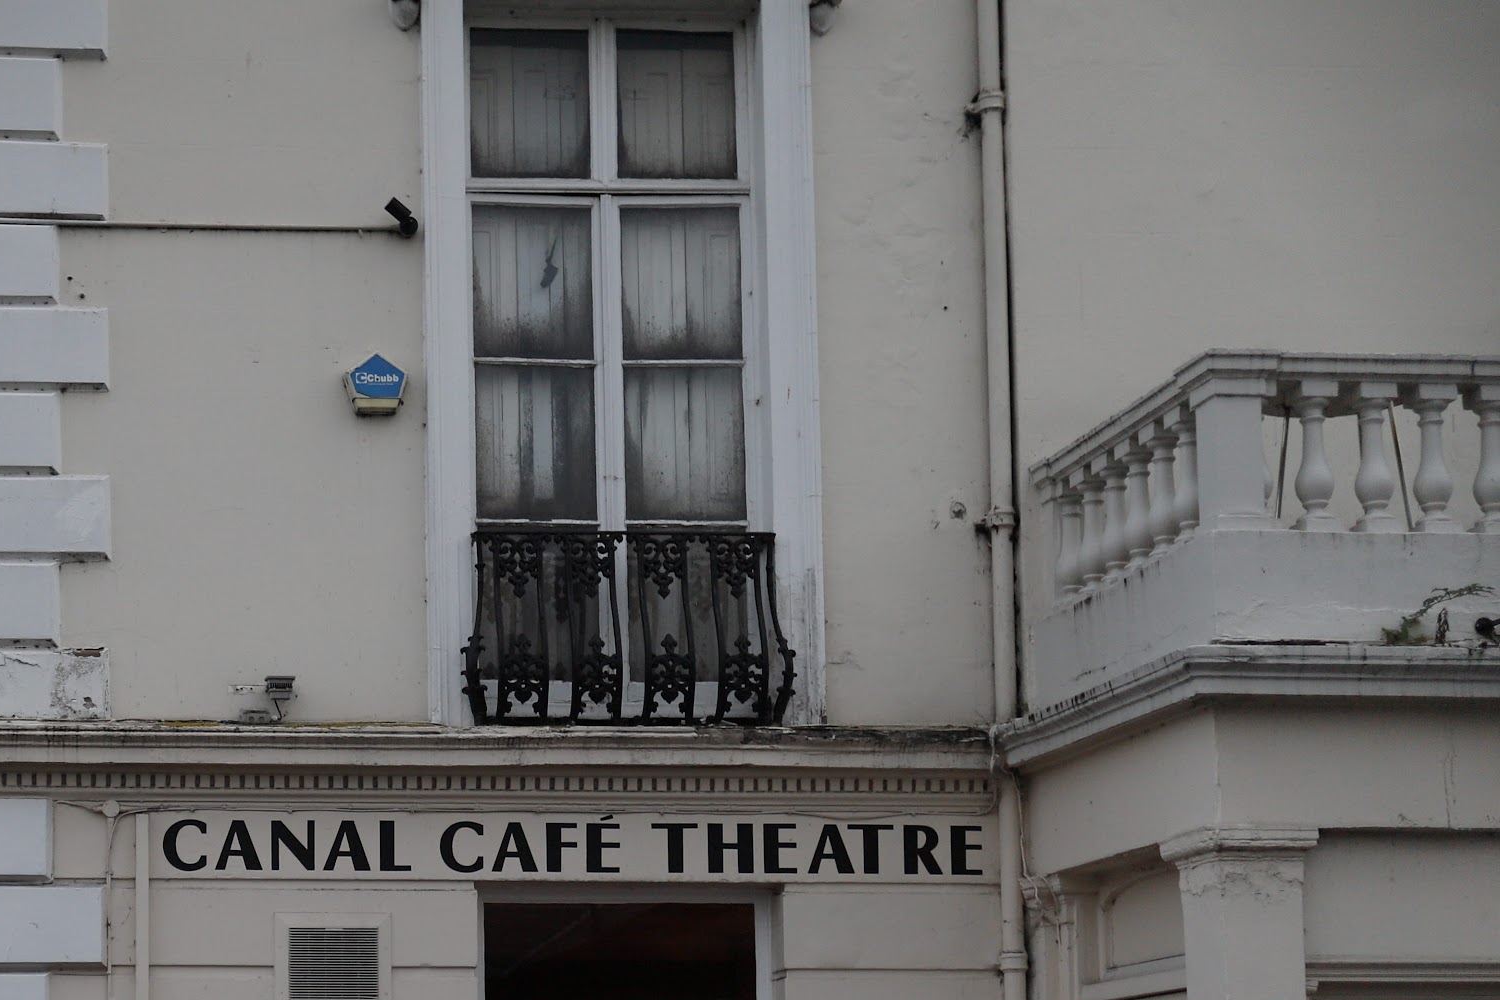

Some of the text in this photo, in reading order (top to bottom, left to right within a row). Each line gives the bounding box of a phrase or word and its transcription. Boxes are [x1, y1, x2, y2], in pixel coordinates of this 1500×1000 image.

[367, 374, 399, 383] Chubb
[162, 815, 983, 876] CANAL CAFÉ THEATRE
